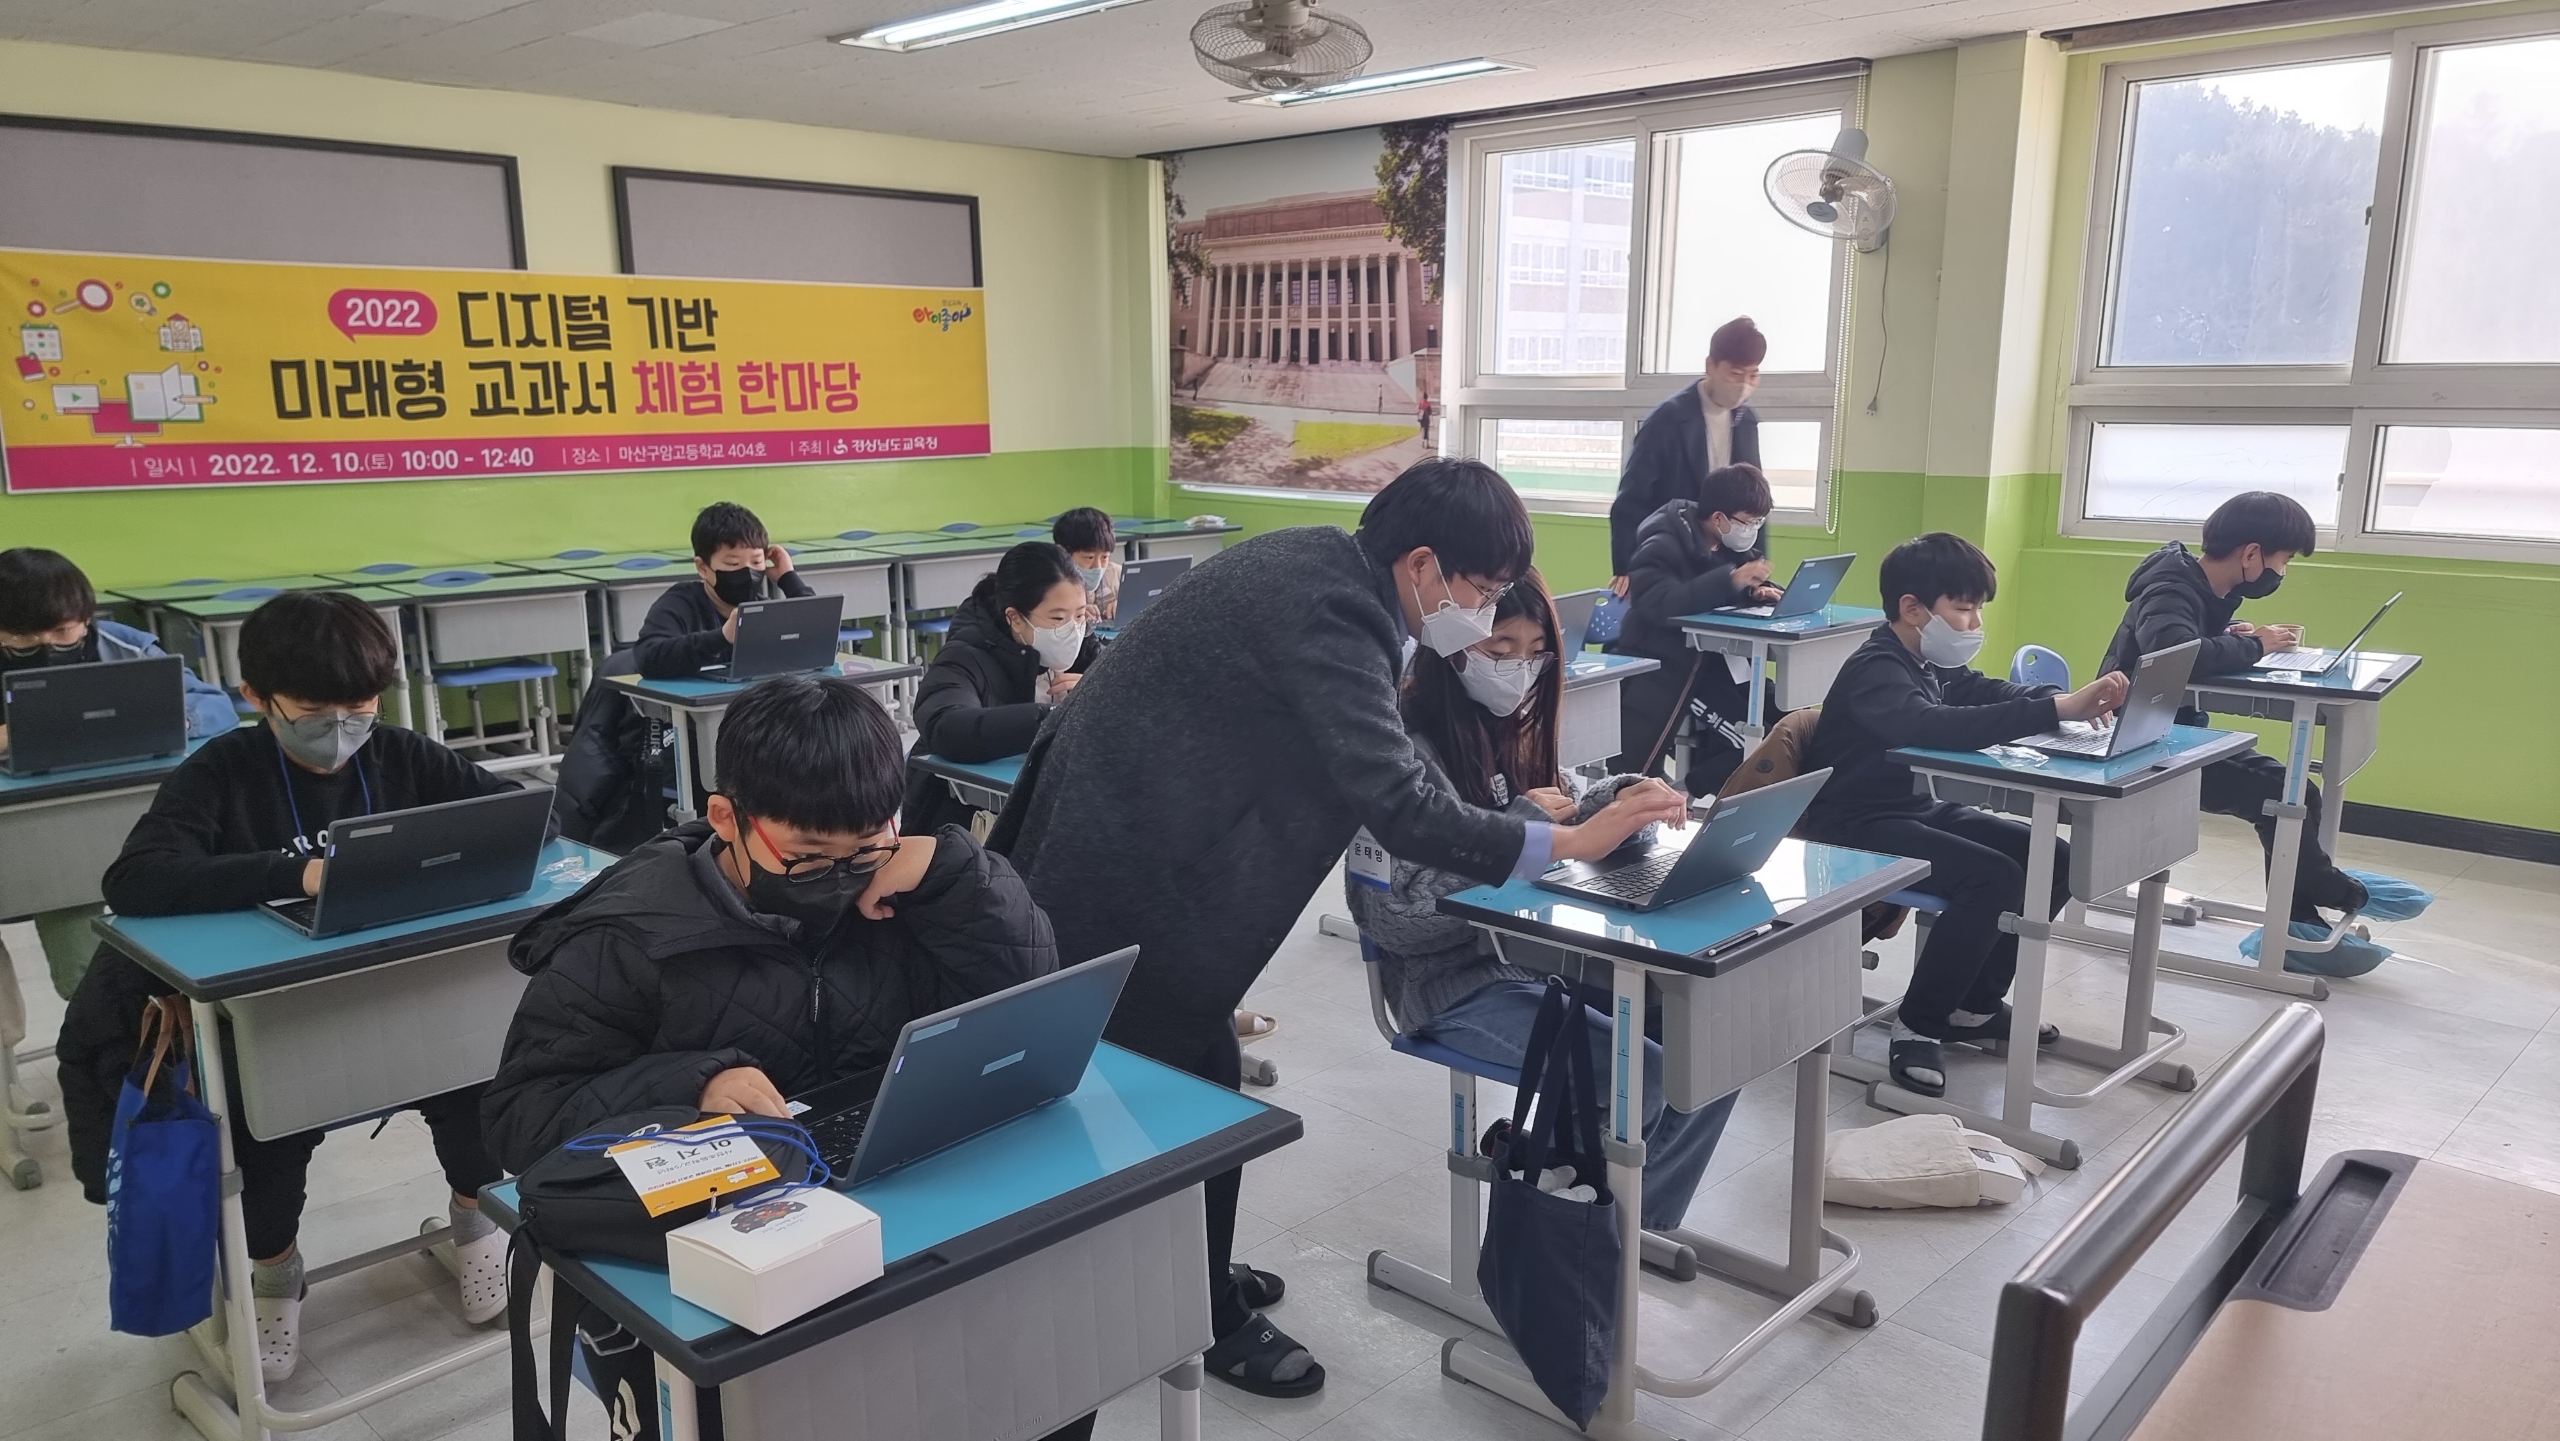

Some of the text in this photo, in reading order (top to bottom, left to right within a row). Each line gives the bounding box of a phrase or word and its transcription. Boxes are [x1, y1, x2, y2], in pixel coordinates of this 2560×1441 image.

[346, 297, 421, 328] 2022
[457, 291, 718, 352] 디지털 기반
[270, 358, 861, 420] 미래형 교과서 체험 한마당
[619, 442, 767, 463] 마산구암고등학교 404호
[799, 441, 821, 456] 주최
[851, 436, 938, 453] 경상남도교육청
[208, 453, 281, 476] 2022.
[287, 453, 324, 474] 12.
[401, 449, 459, 471] 10:00
[481, 446, 534, 469] 12:40
[572, 448, 601, 465] 장소
[144, 457, 184, 478] 일시
